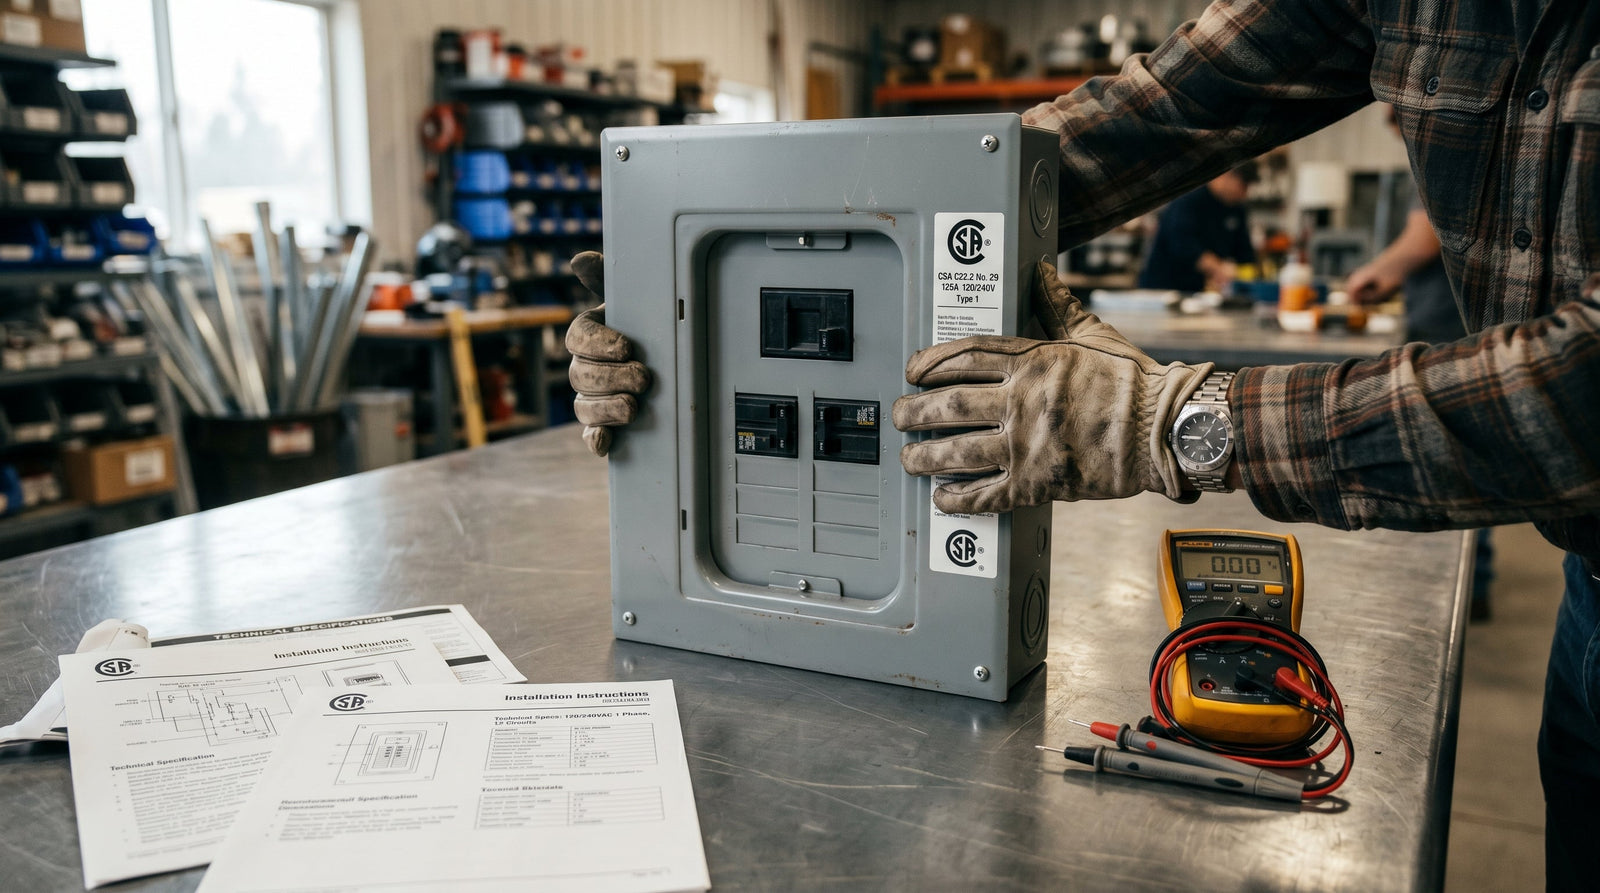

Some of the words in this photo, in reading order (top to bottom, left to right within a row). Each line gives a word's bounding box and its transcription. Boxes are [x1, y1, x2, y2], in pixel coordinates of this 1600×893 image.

[947, 219, 986, 265] CSA
[938, 272, 953, 281] CSA
[954, 273, 974, 281] C22.2
[976, 273, 988, 282] No.
[989, 273, 999, 282] 29
[942, 283, 959, 291] 125A
[962, 283, 996, 292] 120/240V
[956, 294, 973, 304] Type
[975, 295, 979, 303] 1
[945, 529, 978, 568] CSA
[1211, 556, 1261, 575] 0.00
[213, 628, 290, 640] TECHNICAL
[293, 616, 394, 633] SPECIFICATIONS
[273, 645, 340, 660] Installation
[341, 636, 409, 651] Instructions
[94, 657, 135, 676] CSA
[329, 693, 368, 711] CSA
[504, 692, 573, 701] Installation
[576, 691, 649, 699] Instructions
[110, 761, 154, 771] Technical
[156, 753, 215, 766] Specification
